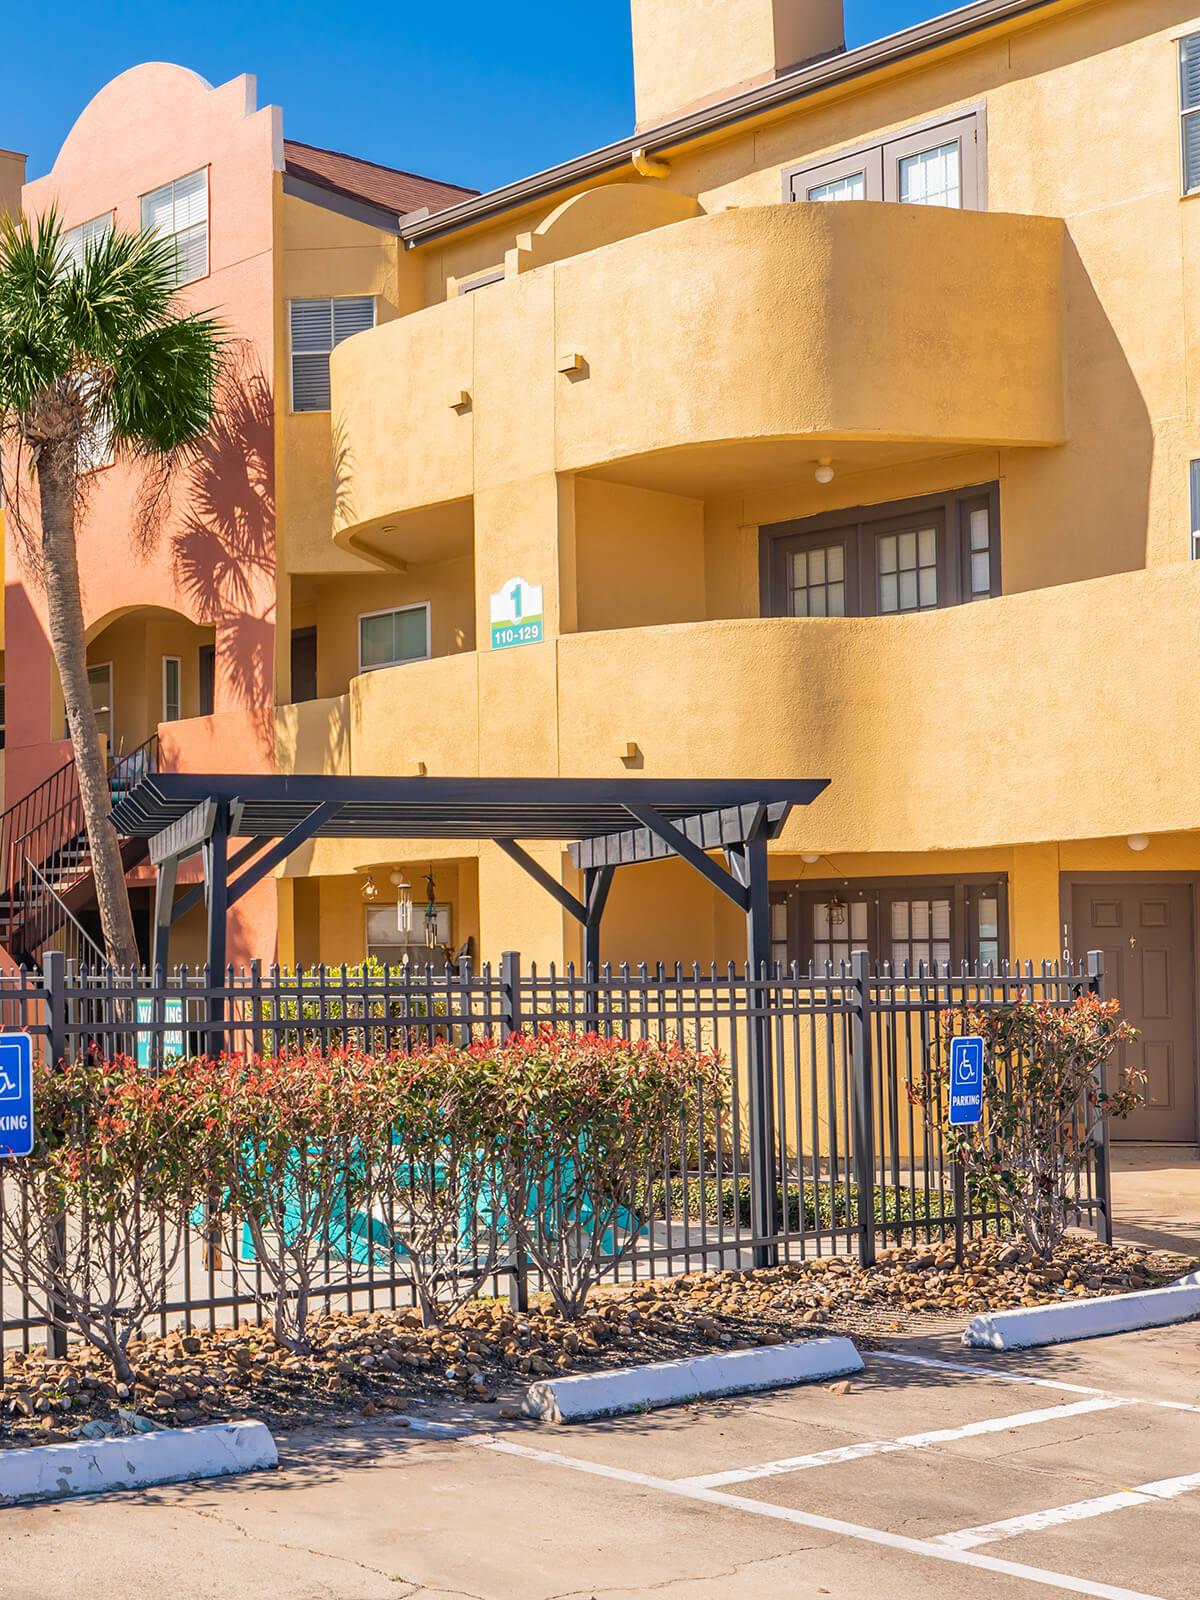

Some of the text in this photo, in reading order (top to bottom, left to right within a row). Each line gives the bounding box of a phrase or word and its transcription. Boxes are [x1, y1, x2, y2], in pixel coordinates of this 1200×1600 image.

[510, 584, 522, 618] 1
[495, 625, 539, 644] 110-129
[952, 1095, 980, 1107] PARKING
